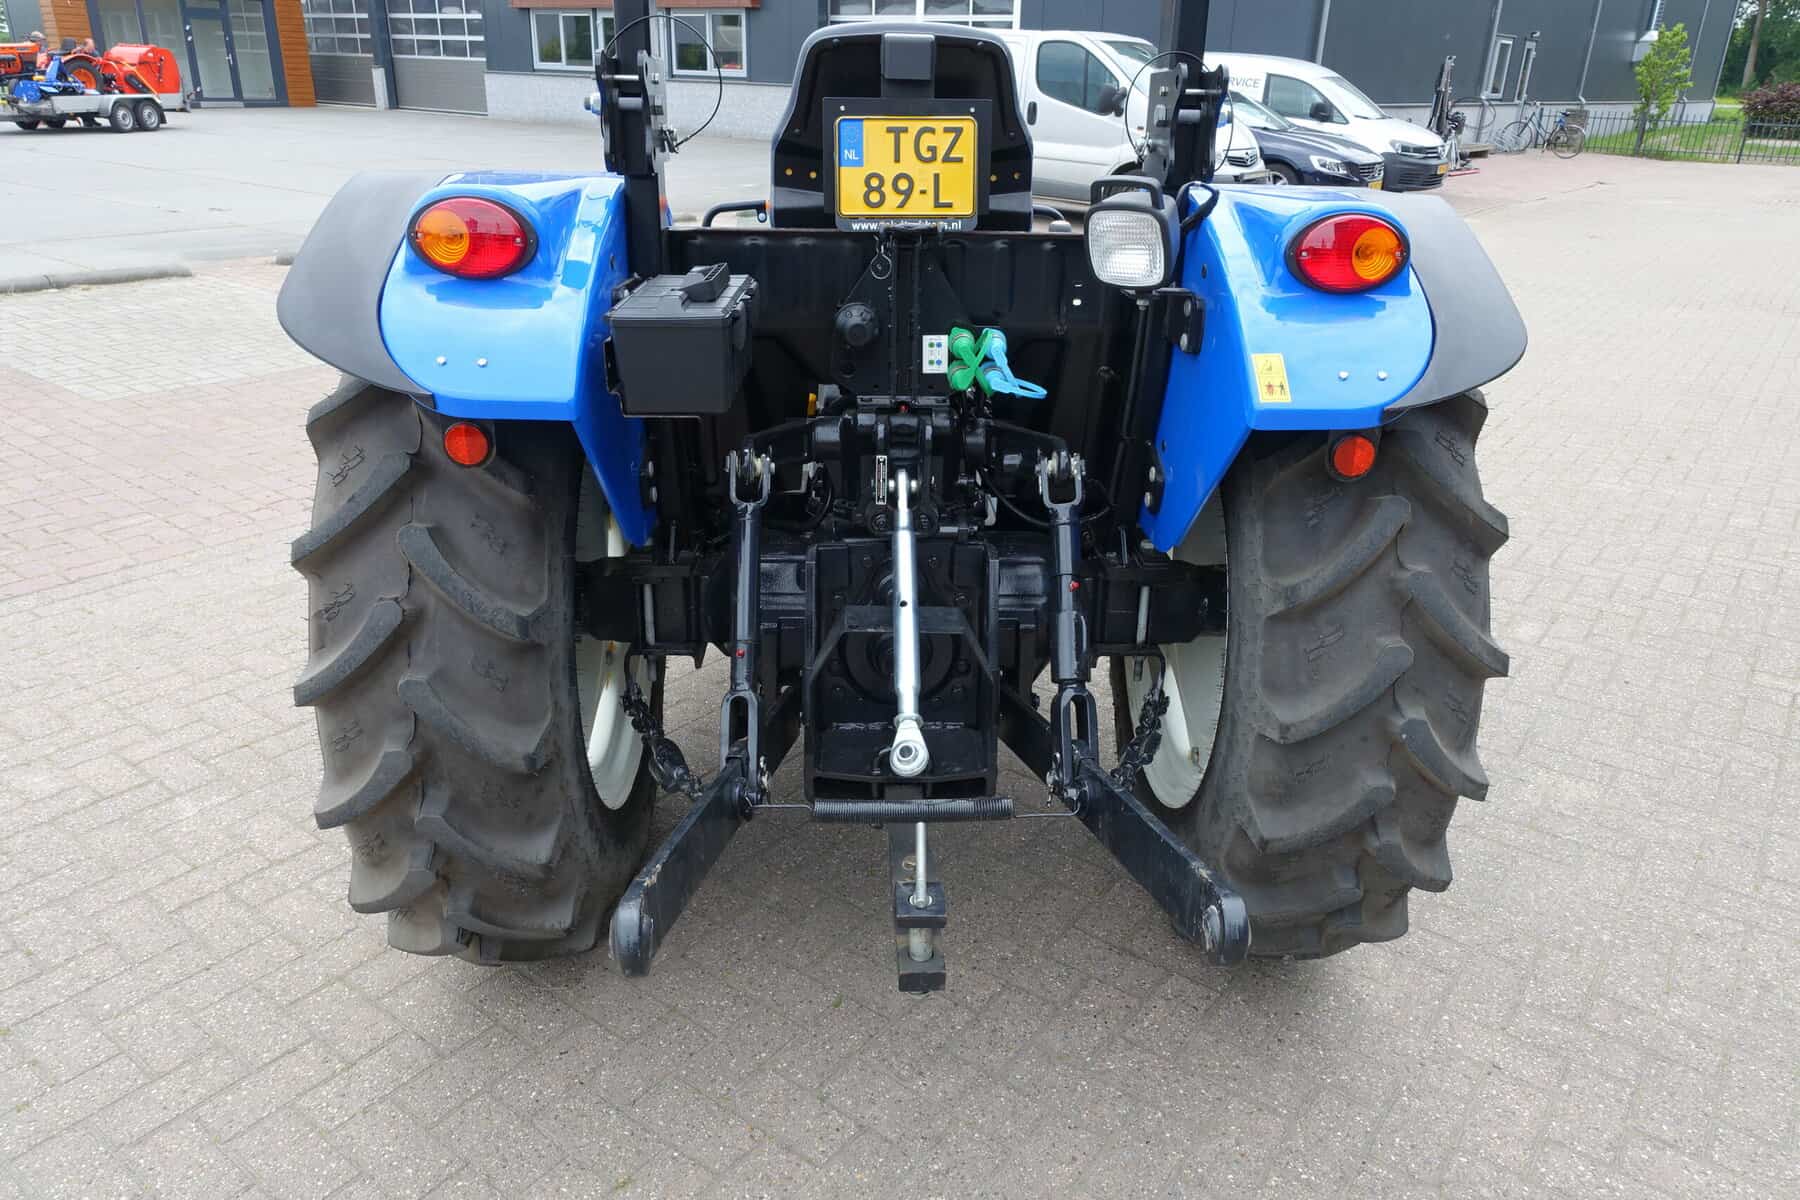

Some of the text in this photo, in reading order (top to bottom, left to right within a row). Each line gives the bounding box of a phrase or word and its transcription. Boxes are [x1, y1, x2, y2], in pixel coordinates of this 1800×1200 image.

[1230, 76, 1262, 88] RVICE
[844, 149, 860, 160] NL
[886, 126, 964, 164] TGZ
[863, 172, 953, 208] 89-L
